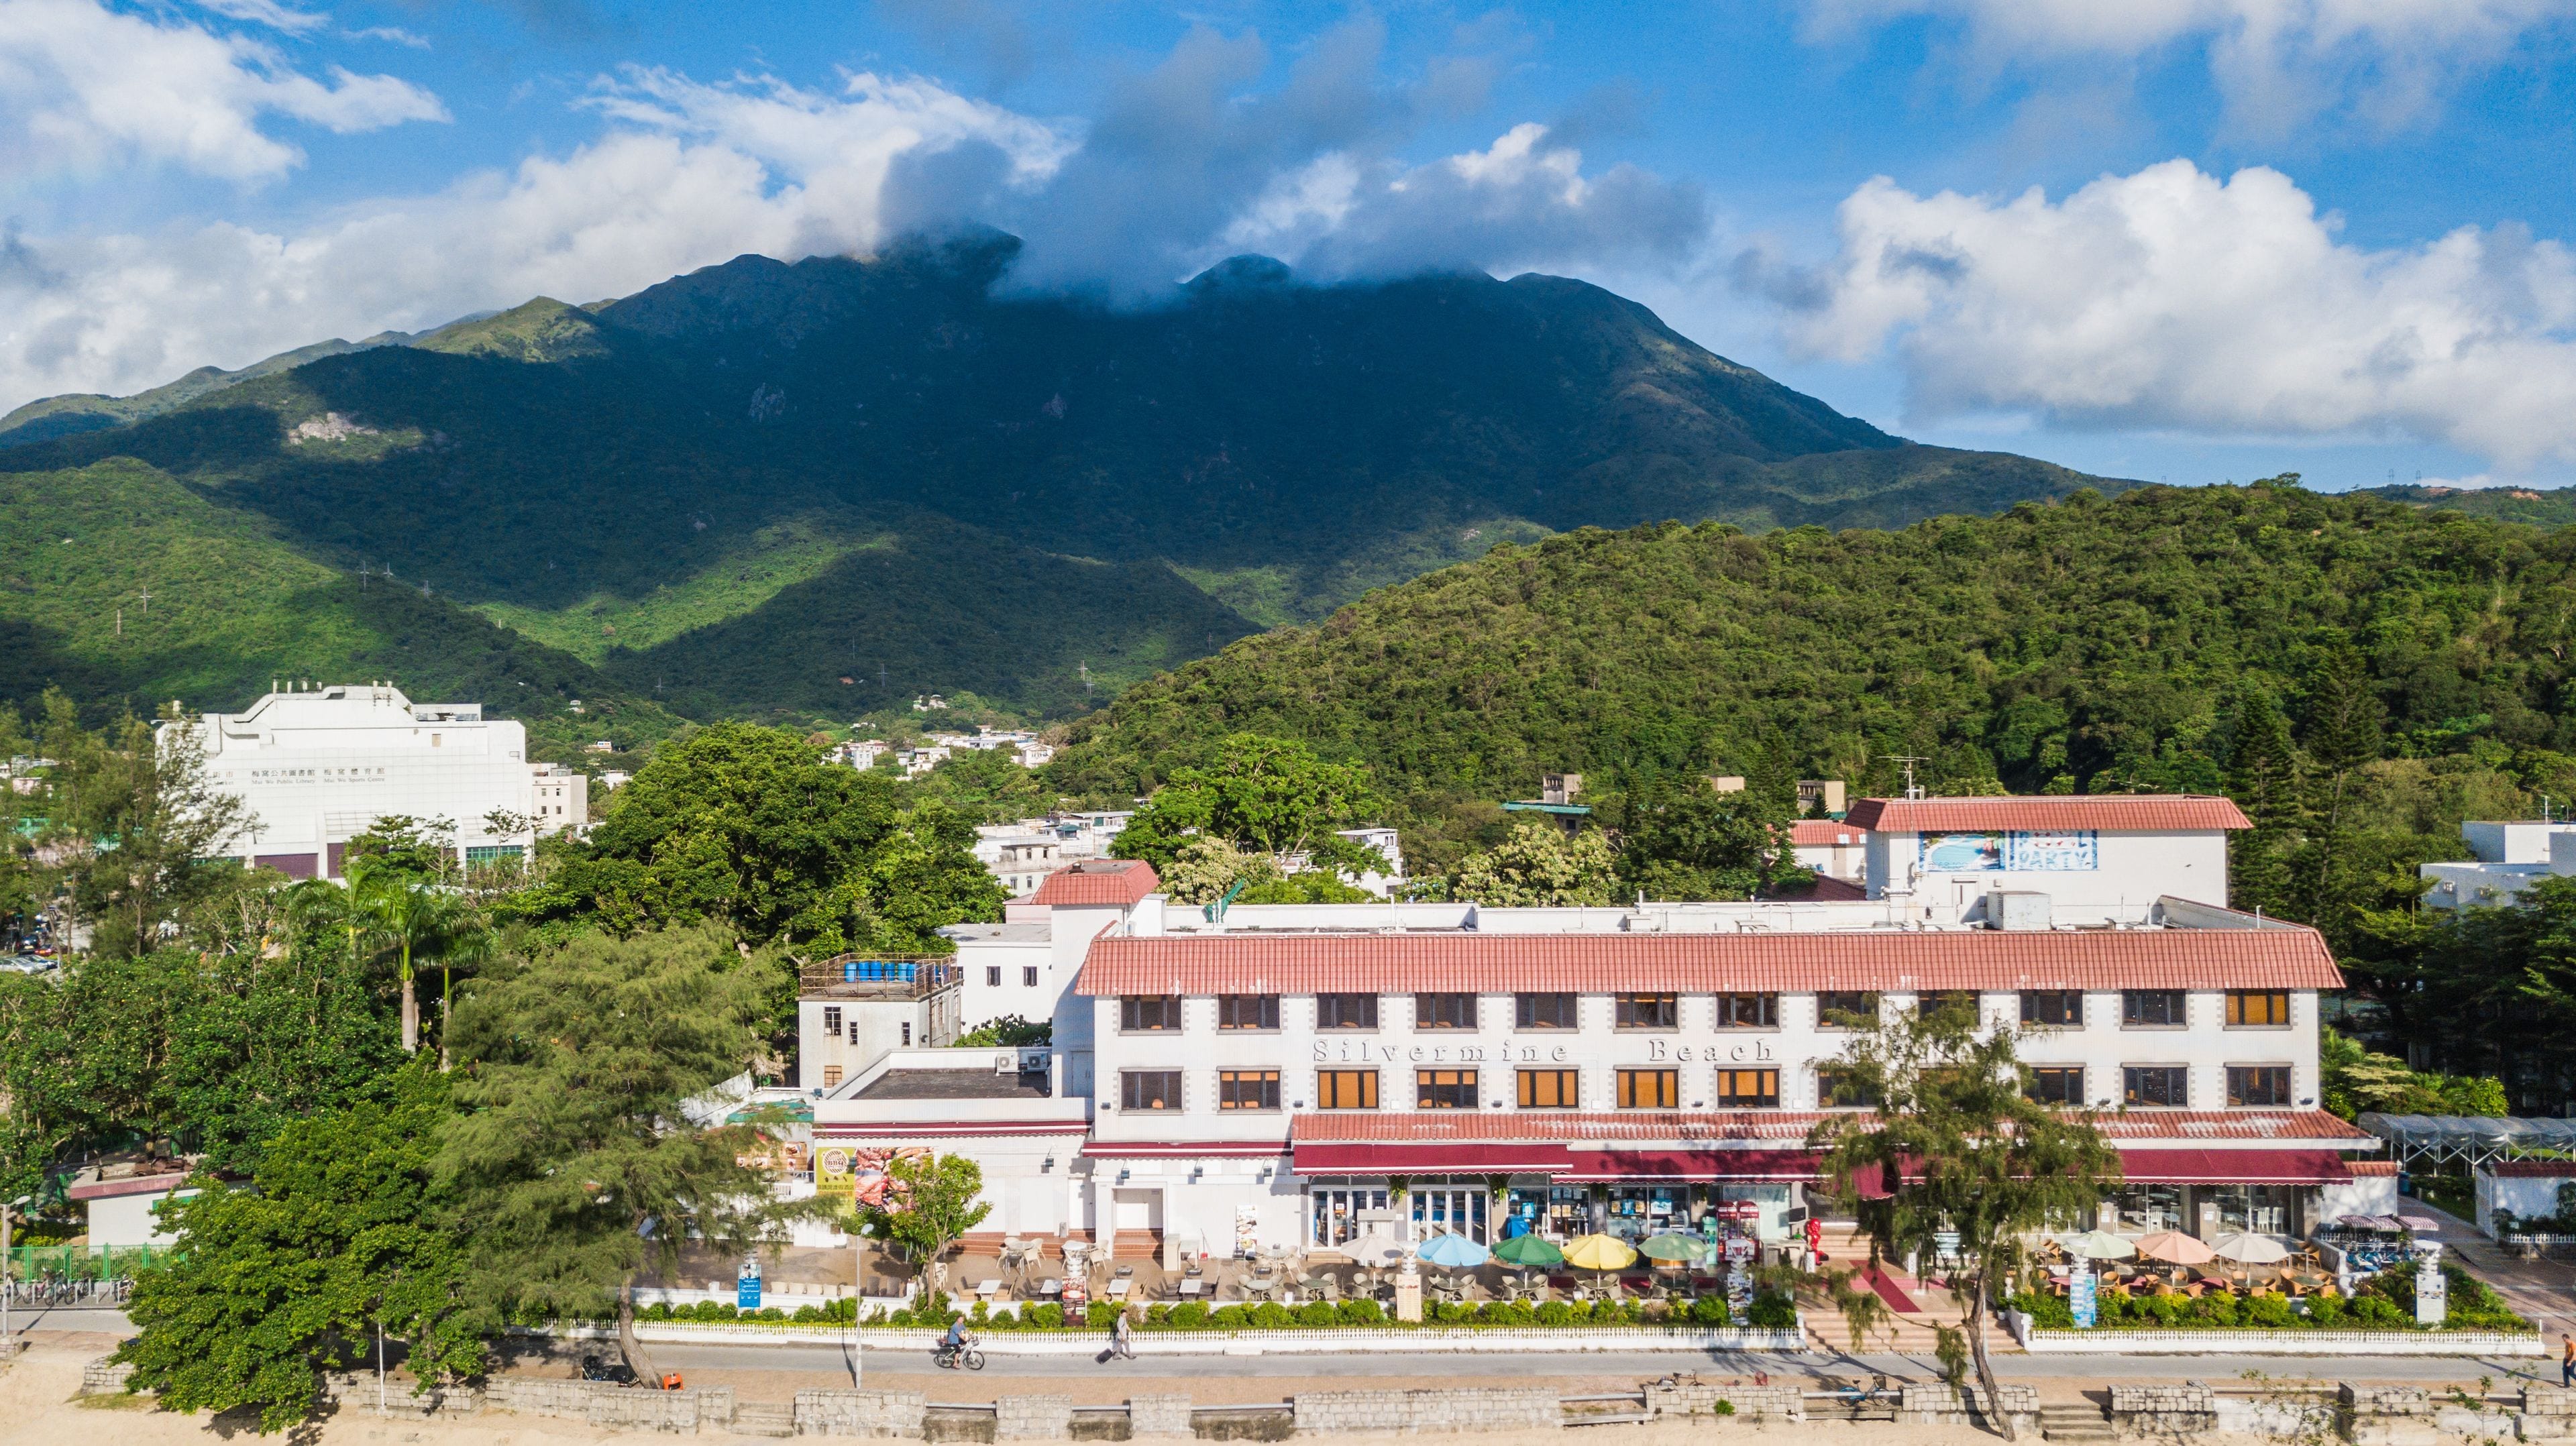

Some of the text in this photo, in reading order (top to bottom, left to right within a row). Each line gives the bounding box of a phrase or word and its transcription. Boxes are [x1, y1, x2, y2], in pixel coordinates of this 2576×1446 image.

[2019, 850, 2088, 868] PARTY
[1313, 1038, 1774, 1062] Silvermine Beach
